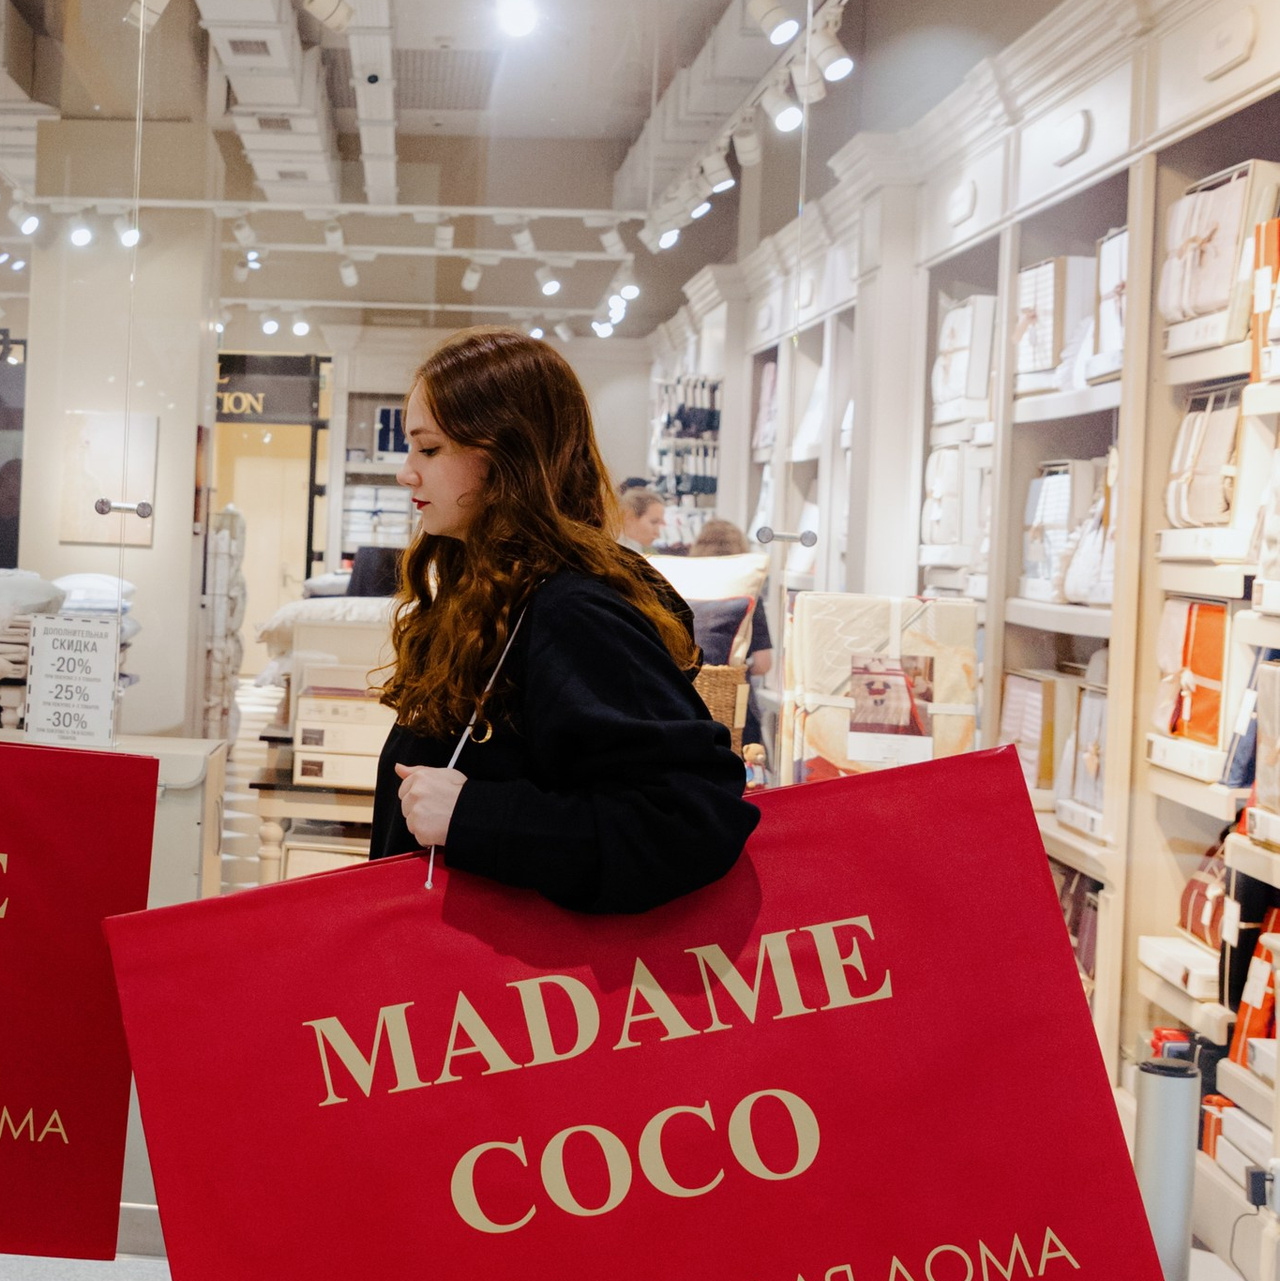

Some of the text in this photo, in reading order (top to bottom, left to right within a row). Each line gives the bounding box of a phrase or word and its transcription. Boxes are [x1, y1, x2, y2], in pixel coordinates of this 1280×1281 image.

[51, 638, 98, 653] СКИДКА
[51, 656, 91, 675] -20%
[48, 683, 90, 702] -25%
[46, 711, 87, 730] -30%
[301, 914, 893, 1107] MADAME
[450, 1088, 821, 1234] COCO
